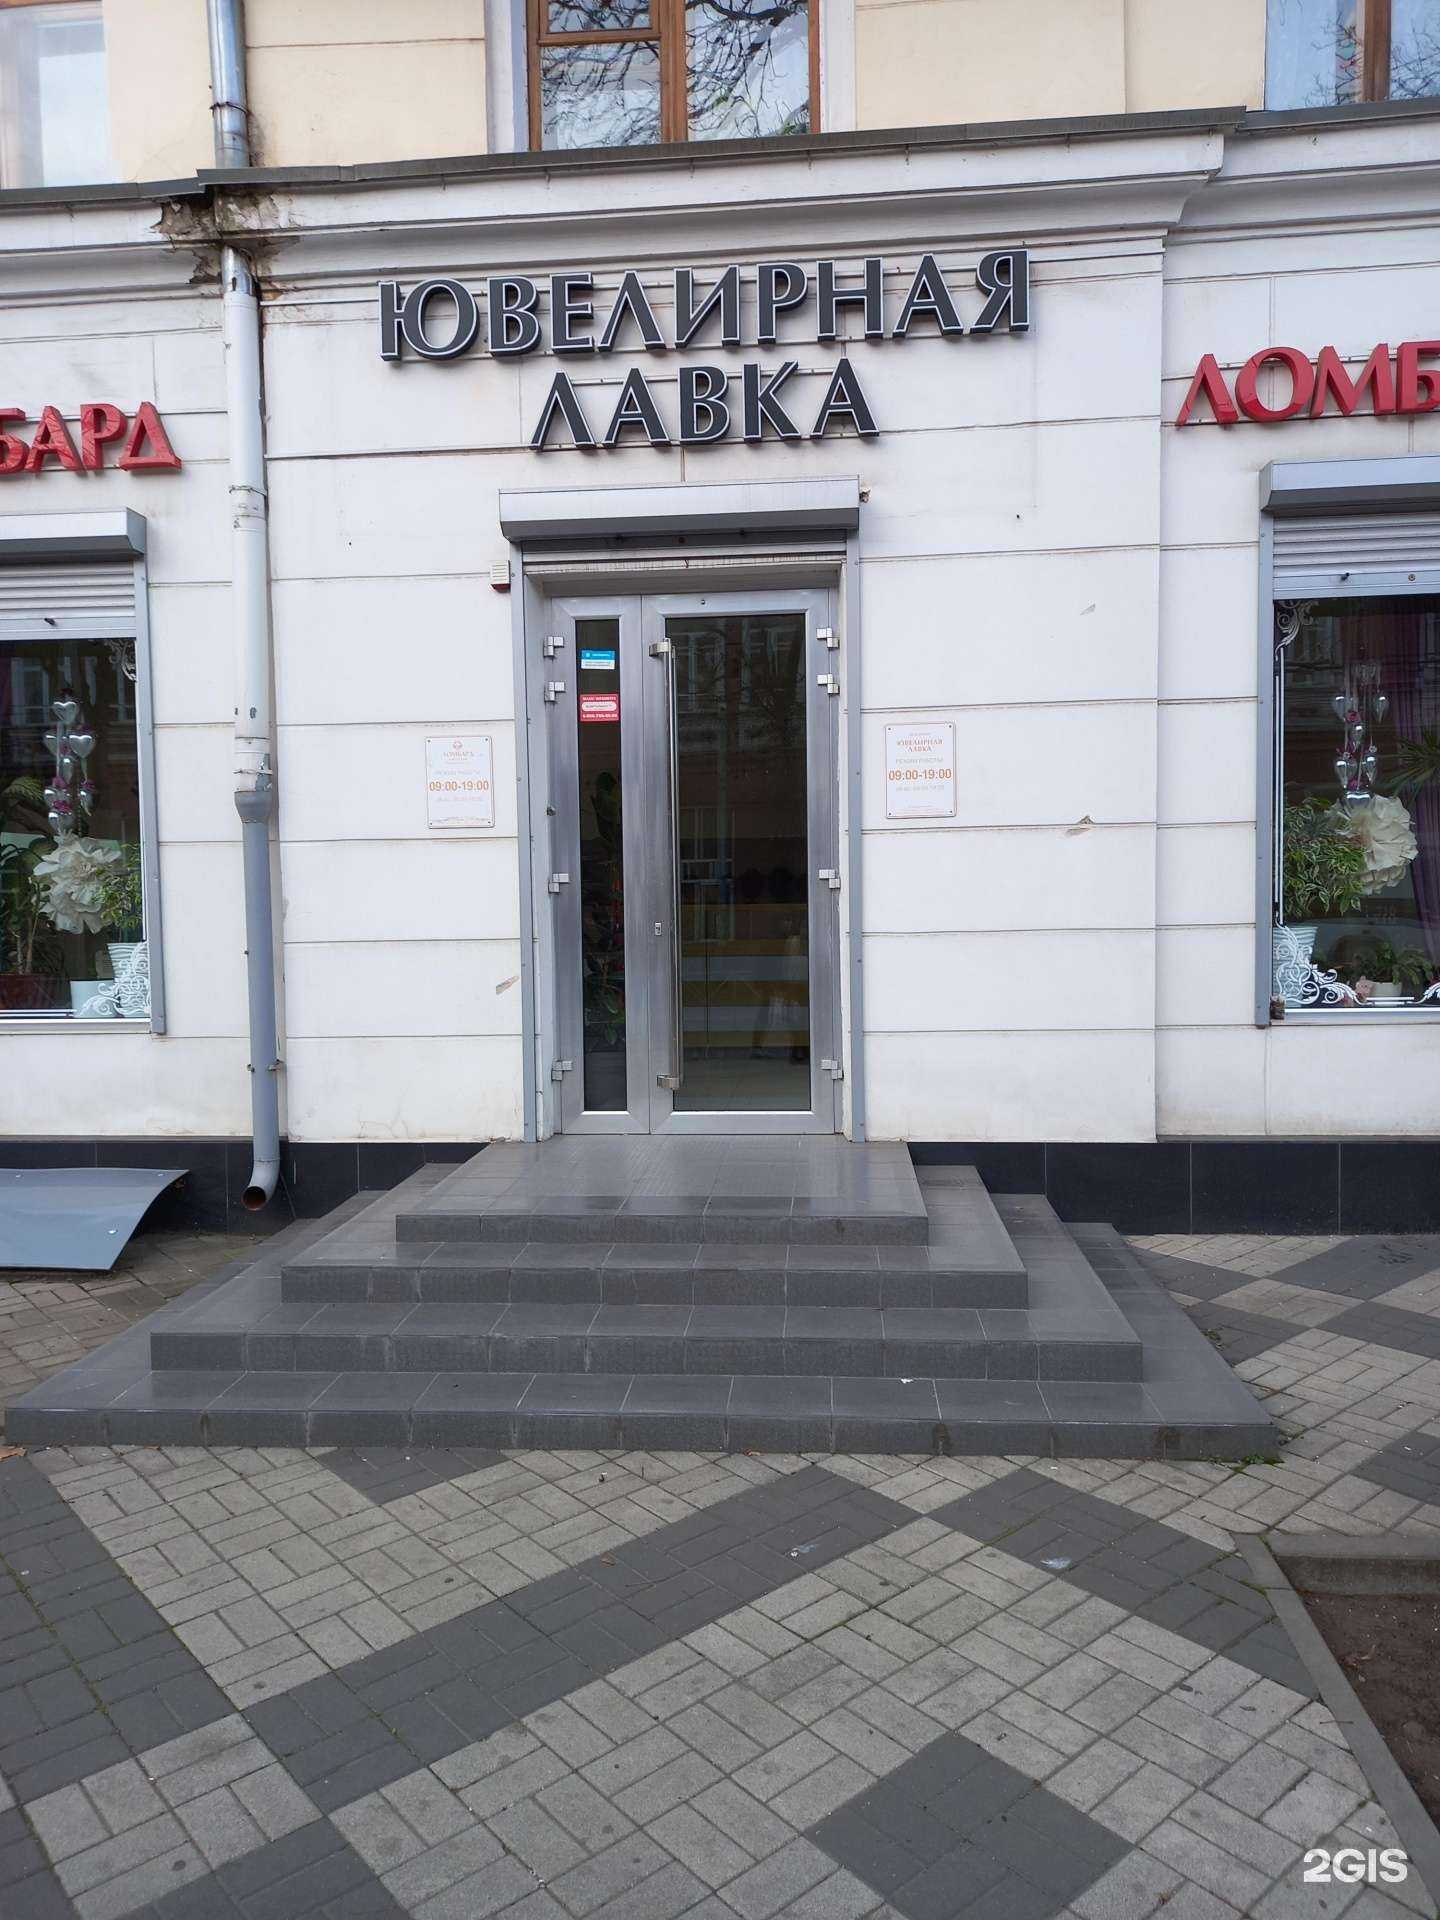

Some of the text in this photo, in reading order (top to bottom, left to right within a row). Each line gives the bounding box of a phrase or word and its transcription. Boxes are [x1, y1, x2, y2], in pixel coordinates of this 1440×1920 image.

[378, 249, 1030, 361] ЮВЕЛИРНАЯ
[530, 357, 880, 451] ЛАВКА
[1175, 340, 1440, 427] ЛОМБ
